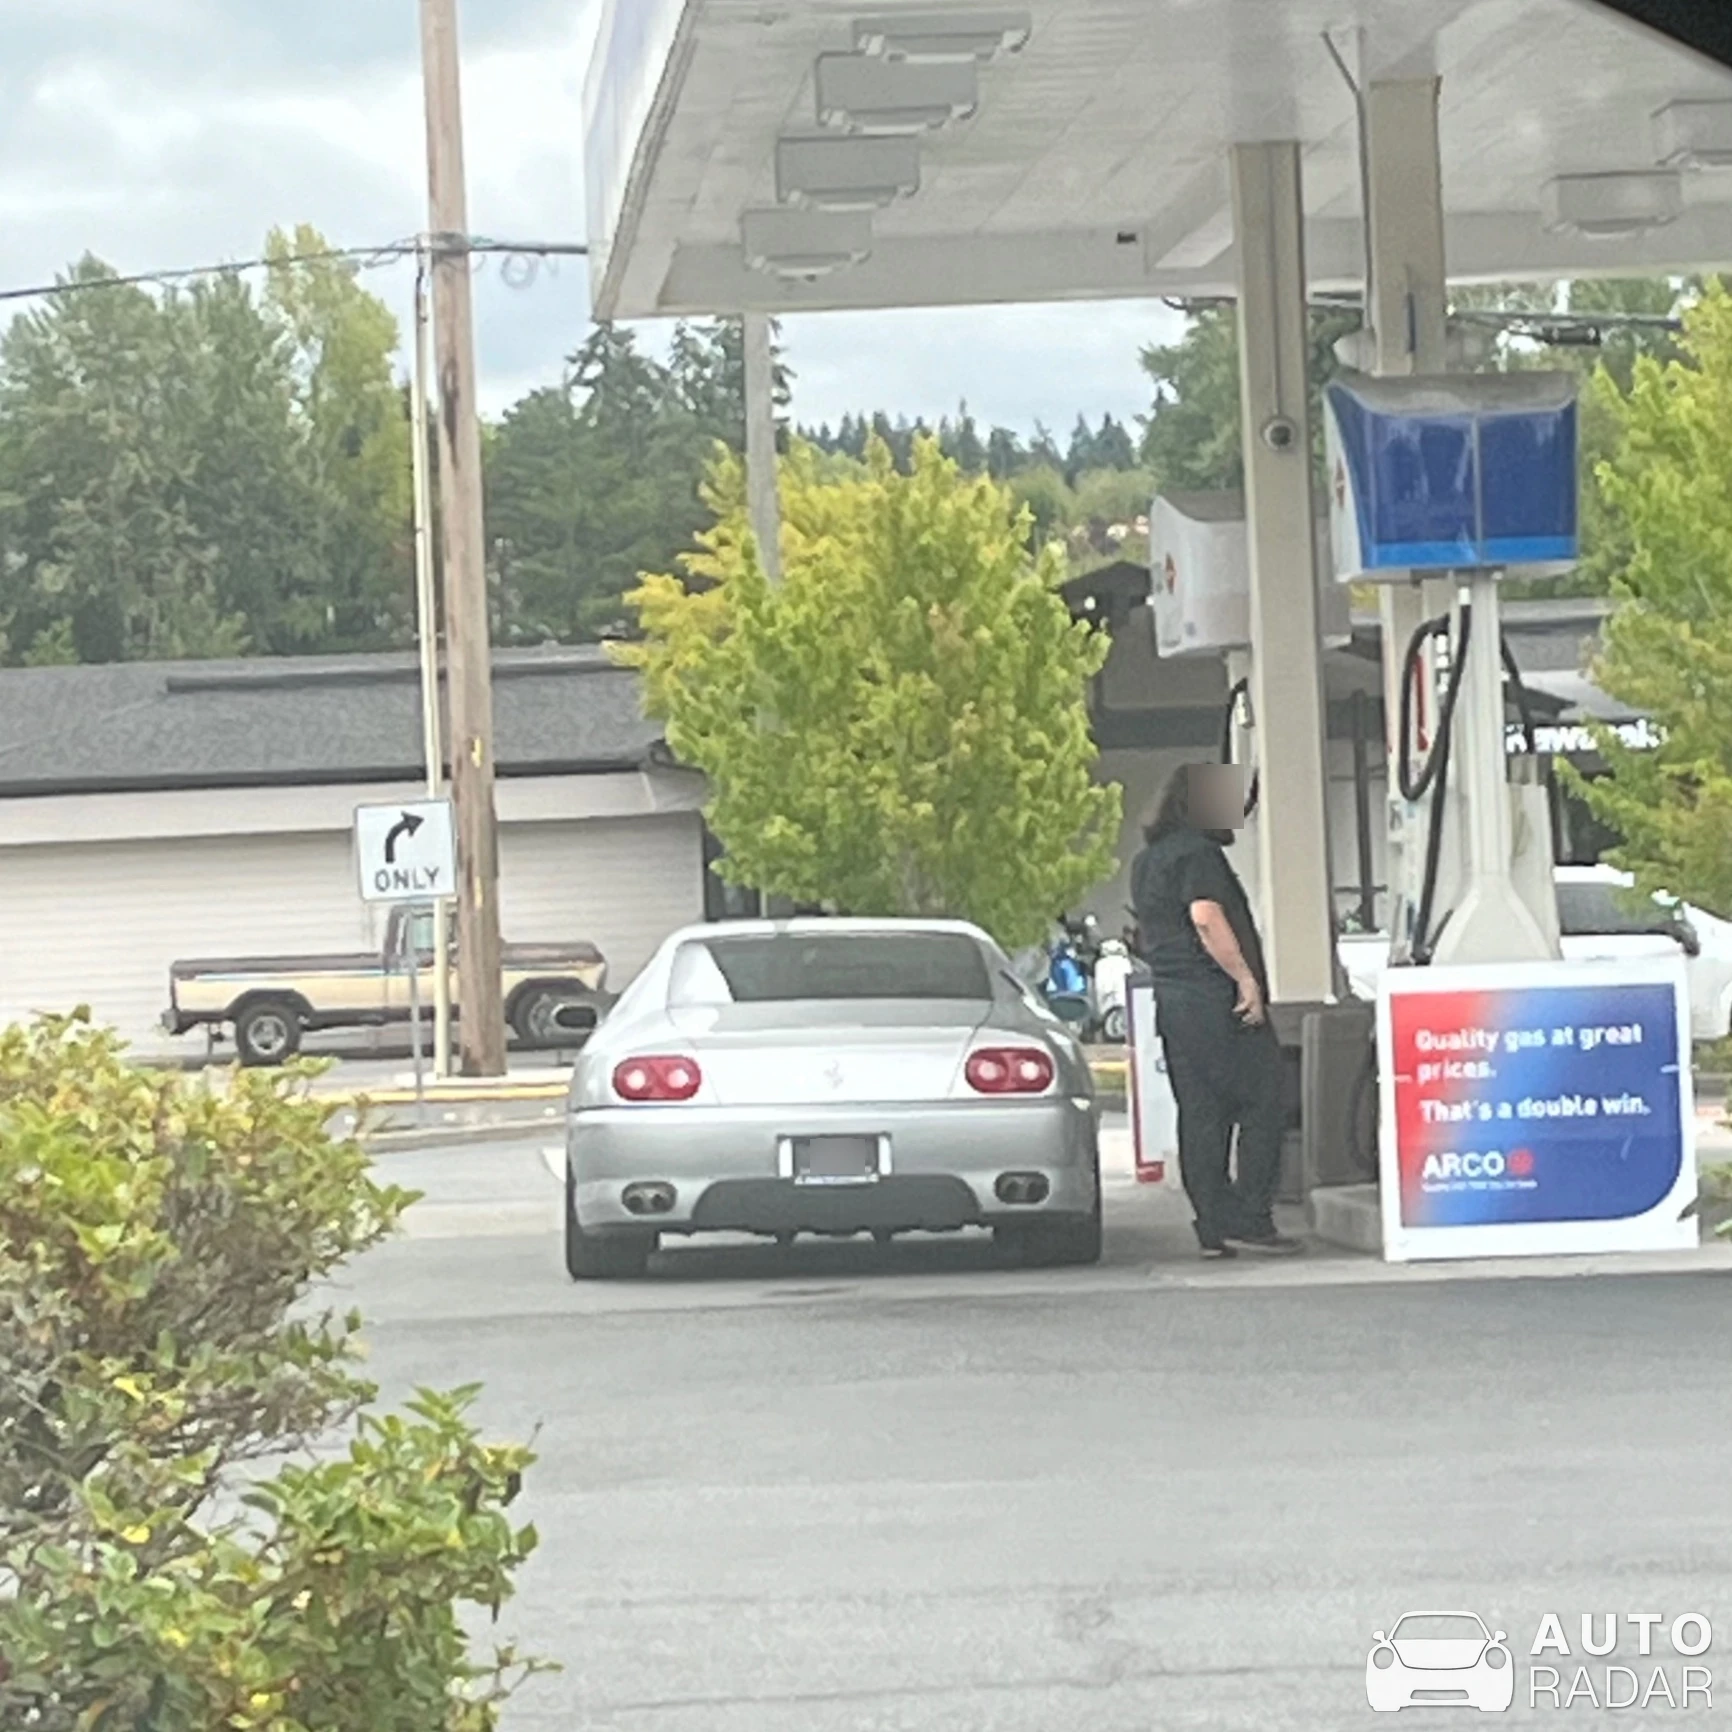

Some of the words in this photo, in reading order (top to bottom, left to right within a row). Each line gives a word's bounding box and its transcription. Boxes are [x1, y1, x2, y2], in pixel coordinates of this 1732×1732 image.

[374, 866, 440, 893] ONLY
[1415, 1028, 1499, 1052] Quality
[1503, 1028, 1547, 1053] gas
[1551, 1025, 1574, 1047] at
[1579, 1023, 1642, 1050] great
[1417, 1059, 1497, 1086] prices.
[1418, 1099, 1493, 1124] That's
[1496, 1101, 1513, 1120] a
[1516, 1095, 1598, 1119] double
[1601, 1092, 1651, 1116] win.
[1422, 1151, 1505, 1178] ARCO
